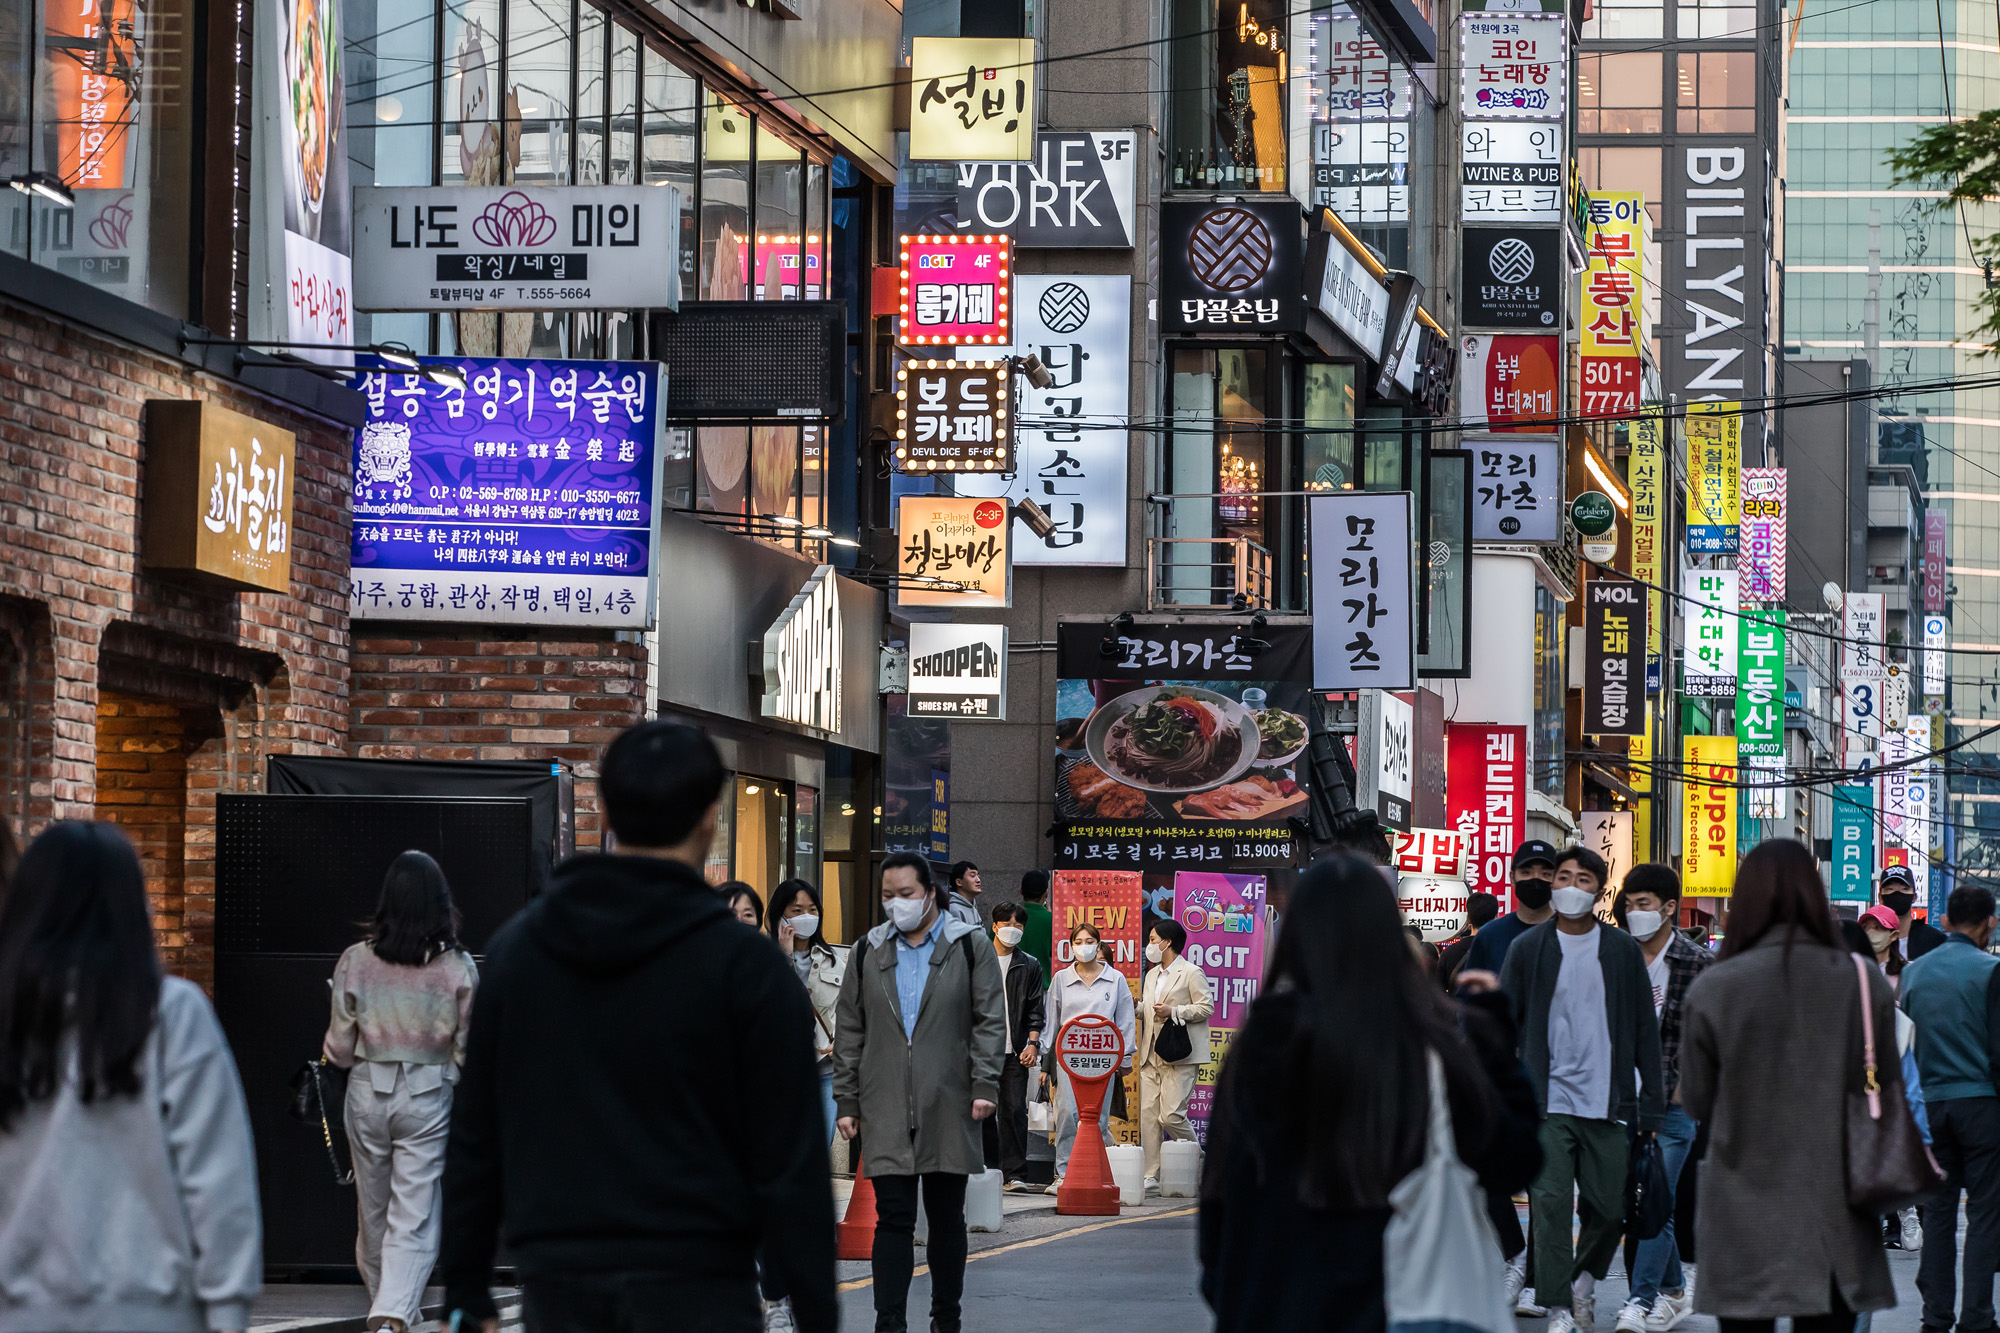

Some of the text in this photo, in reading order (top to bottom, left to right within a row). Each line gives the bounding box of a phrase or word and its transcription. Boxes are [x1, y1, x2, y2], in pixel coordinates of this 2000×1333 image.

[1470, 24, 1520, 34] 천원에 3곡
[1491, 40, 1536, 59] 코인
[1479, 64, 1550, 85] 노래방
[920, 65, 1025, 133] 설빙
[1100, 140, 1130, 160] 3F
[1466, 167, 1559, 182] WINE & PUB
[1465, 190, 1560, 213] 코르크
[1588, 200, 1641, 225] 동아
[391, 204, 640, 248] 나도 미인
[464, 255, 566, 280] 왁싱/네일
[919, 254, 992, 268] AGIT 4F
[1685, 147, 1745, 400] BILLYAN
[430, 288, 591, 300] 토탈뷰티샵 4F T.555-5664
[1481, 285, 1540, 301] 단골손님
[1588, 232, 1637, 346] 부동산
[1181, 299, 1279, 323] 단골손님
[1495, 352, 1520, 381] 놀부
[550, 368, 647, 423] 역술원
[917, 377, 990, 411] 보드
[1491, 386, 1552, 416] 부대찌개
[1584, 392, 1636, 413] 7774
[915, 415, 993, 442] 카페
[912, 448, 938, 456] DEVIL
[940, 448, 960, 456] DICE
[1038, 343, 1090, 548] 단골손님
[1480, 451, 1537, 478] 모리
[459, 487, 527, 501] 02-569-8768
[561, 489, 640, 504] 010-3550-6677
[1478, 481, 1537, 510] 가츠
[1750, 480, 1774, 491] COIN
[353, 502, 640, 521] sulbong540@hanmail.net 서울시 강남구 역삼동 619-17 송암빌딩 402호
[931, 510, 1002, 525] 프리미엄 2~3F
[1575, 505, 1610, 519] Carlsberg
[1744, 500, 1781, 517] 라라
[393, 528, 424, 543] 모르는
[484, 530, 519, 546] 아니다!
[936, 523, 977, 537] 이자카야
[1501, 521, 1519, 530] 지하
[434, 548, 454, 562] 나의
[546, 551, 566, 566] 알면
[593, 552, 628, 568] 보인다!
[904, 529, 1002, 574] 청담이상
[1928, 519, 1942, 601] 스페인어
[1339, 515, 1388, 671] 모리가츠
[1594, 587, 1638, 603] MOL
[1699, 577, 1724, 671] 반지대학
[913, 641, 998, 678] SHOOPEN
[1117, 636, 1252, 671] 모리가츠
[1843, 669, 1883, 677] T.562-1222
[1602, 658, 1629, 727] 연습장
[1686, 685, 1736, 695] 553-9858
[1742, 632, 1779, 739] 부동산
[918, 698, 988, 714] SHOES SPA 슈펜
[1739, 743, 1780, 754] 508-5007
[935, 779, 944, 803] FOR
[932, 809, 947, 834] LEASE
[1704, 765, 1734, 857] Super
[1096, 826, 1112, 837] 정식
[1153, 827, 1197, 838] 미니돈가스
[1206, 827, 1236, 838] 초밥(5)
[1064, 844, 1291, 860] 이 모든 걸 다 드리고 15,900원
[1395, 832, 1464, 876] 김밥
[1843, 826, 1860, 881] BAR
[1185, 883, 1264, 909] 신규 4F
[1398, 898, 1467, 913] 부대찌개
[1067, 905, 1128, 930] NEW
[1182, 905, 1254, 933] OPEN
[1188, 944, 1250, 969] AGIT
[1068, 1033, 1114, 1049] 주차금지
[1070, 1057, 1111, 1068] 동일빌딩
